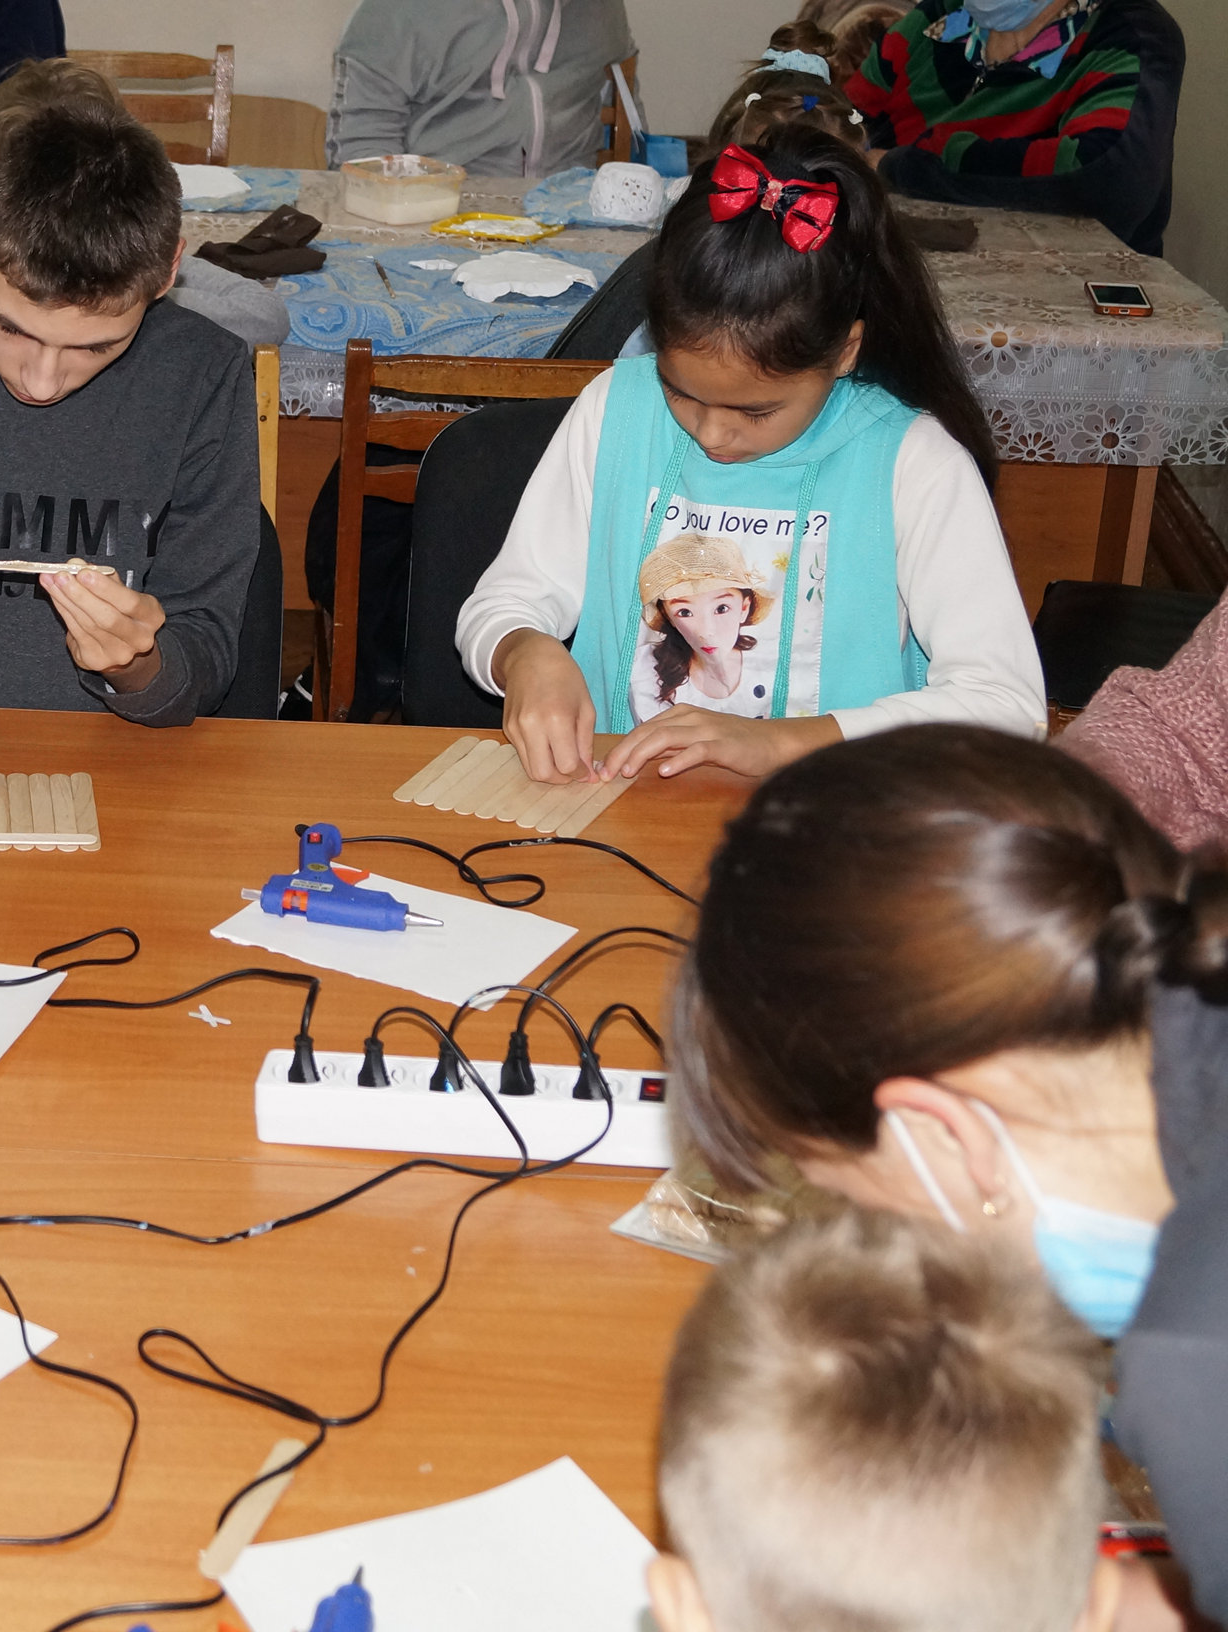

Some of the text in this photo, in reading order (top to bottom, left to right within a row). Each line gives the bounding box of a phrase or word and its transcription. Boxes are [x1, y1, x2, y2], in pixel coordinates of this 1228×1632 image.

[650, 500, 680, 521] o
[681, 509, 711, 532] you
[718, 511, 768, 536] love
